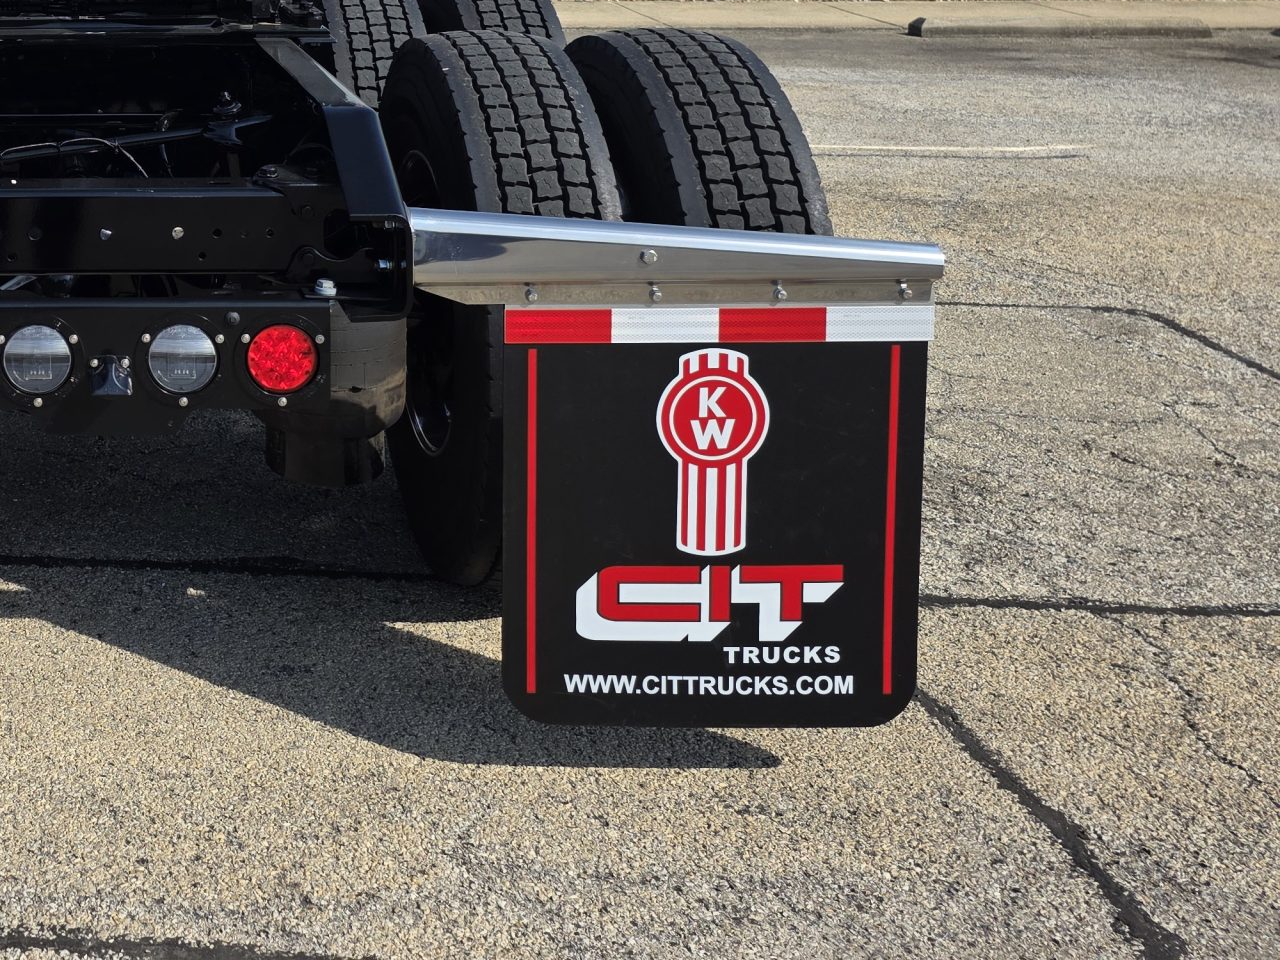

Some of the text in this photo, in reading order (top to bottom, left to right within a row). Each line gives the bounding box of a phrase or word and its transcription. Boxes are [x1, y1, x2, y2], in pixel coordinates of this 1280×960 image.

[575, 564, 845, 642] CIT
[722, 646, 841, 664] TRUCKS
[563, 674, 855, 696] WWW.CITTRUCKS.COM
